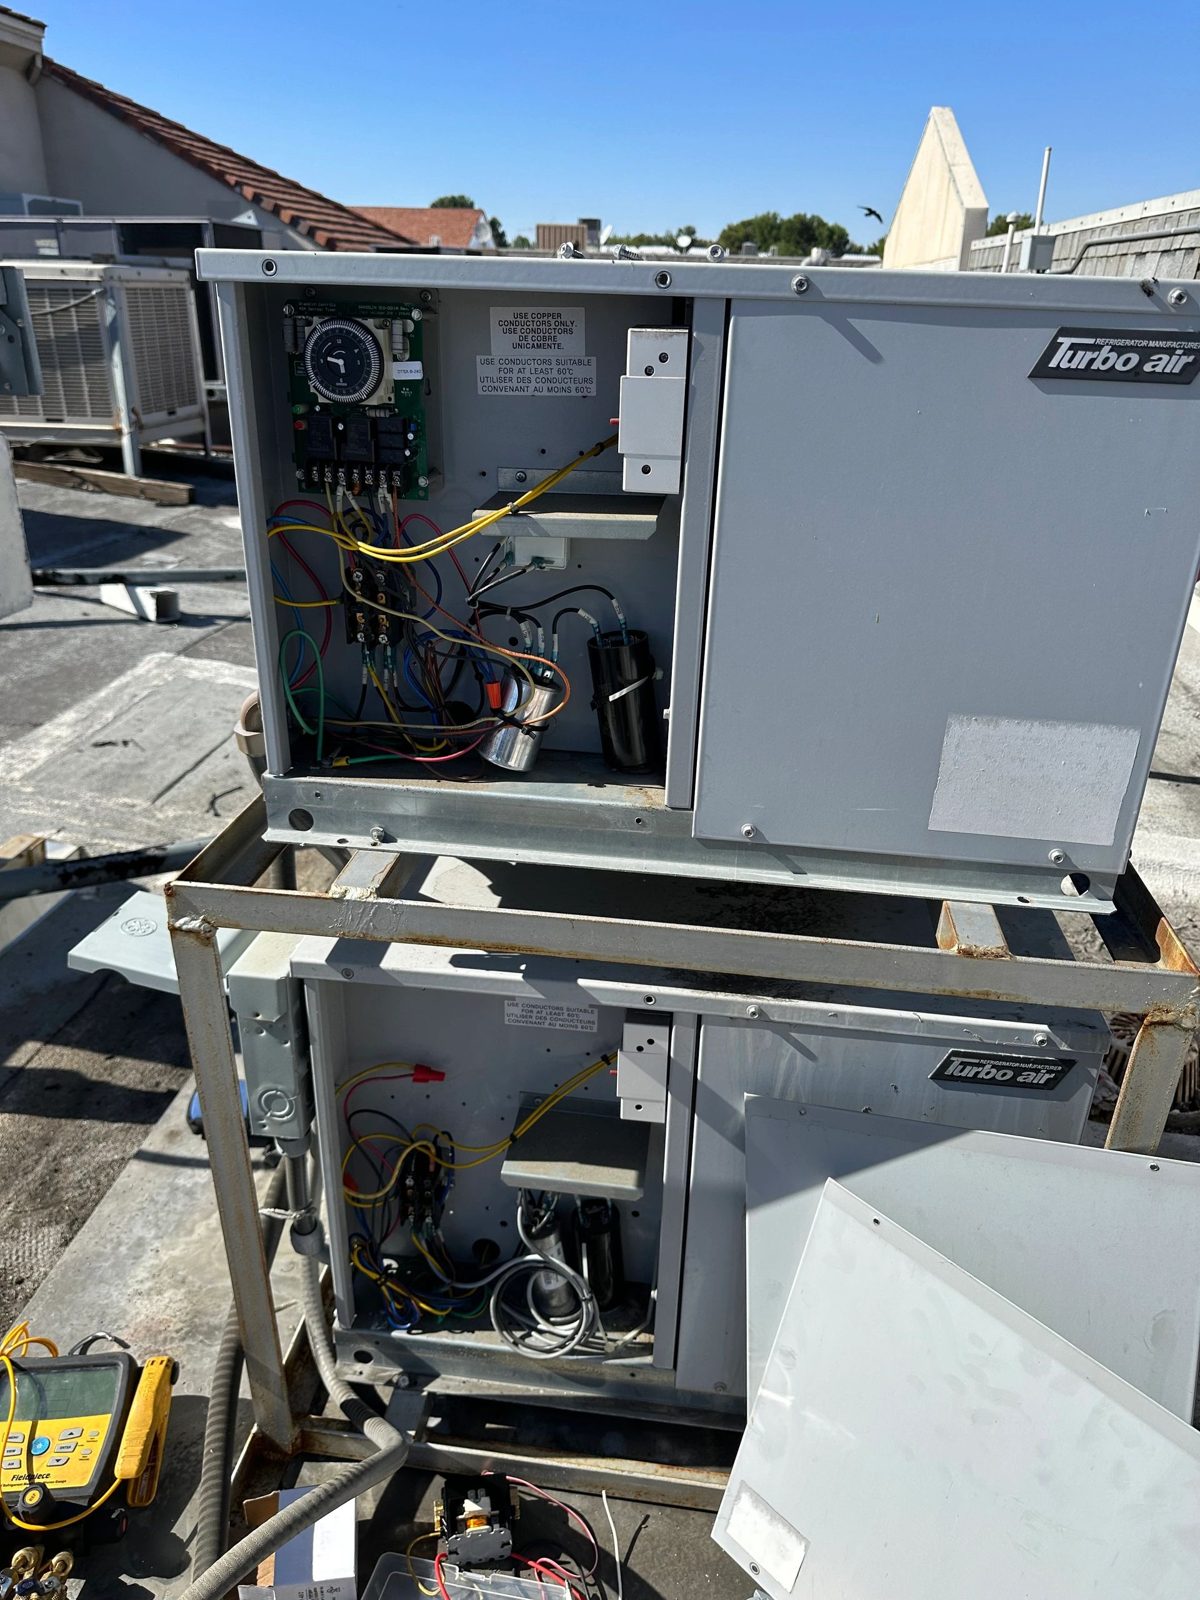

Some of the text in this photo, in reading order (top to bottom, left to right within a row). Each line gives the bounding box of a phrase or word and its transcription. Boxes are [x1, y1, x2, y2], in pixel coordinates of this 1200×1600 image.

[513, 312, 562, 320] USE COPPER
[498, 320, 578, 328] CONDUCTORS ONLY.
[502, 327, 574, 335] USE CONDUCTORS
[531, 335, 558, 343] COBRE
[1095, 338, 1149, 347] REFRIGERATOR
[512, 342, 565, 350] UNICAMENTE.
[1048, 336, 1195, 374] Turbo air
[480, 358, 592, 367] USE CONDUCTORS SUITABLE
[498, 367, 514, 375] FOR
[517, 367, 527, 375] AT
[529, 367, 554, 375] LEAST
[479, 376, 594, 385] UTILISER DES CONDUCTEURS
[481, 385, 530, 393] CONVENANT
[533, 385, 544, 393] AU
[547, 386, 572, 394] MOINS
[521, 1002, 564, 1012] CONDUCTORS
[566, 1007, 595, 1015] SUITABLE
[506, 1012, 533, 1020] UTILISER
[549, 1016, 596, 1026] CONDUCTEURS
[507, 1018, 545, 1026] CONVENANT
[558, 1022, 579, 1030] MOINS
[944, 1056, 1056, 1084] Turbo air
[979, 1059, 1063, 1072] REFRIGERATOR MANUFACTURER
[11, 1473, 51, 1482] Fieldpiece
